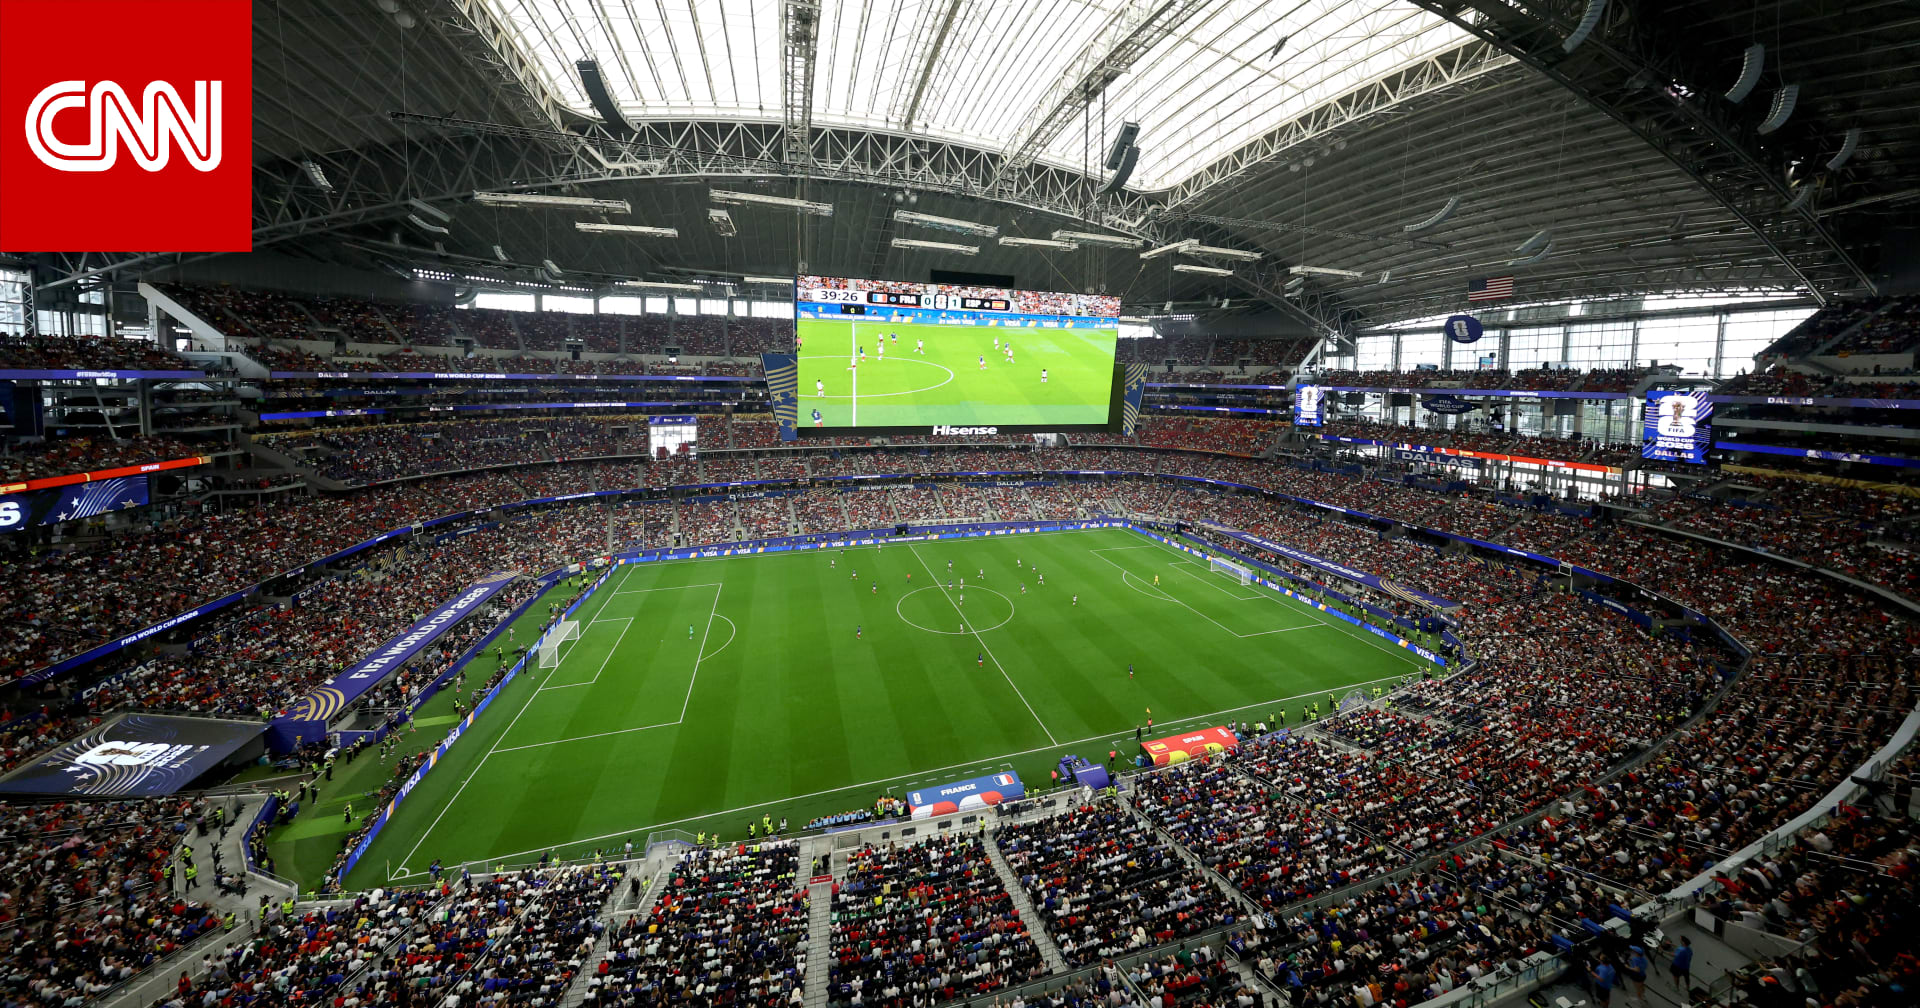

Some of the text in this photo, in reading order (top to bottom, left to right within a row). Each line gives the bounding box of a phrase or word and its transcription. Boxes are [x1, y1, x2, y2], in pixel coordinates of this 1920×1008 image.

[820, 290, 981, 308] 39:26 FRA 0 1 ESP
[933, 425, 998, 436] Hisense
[1655, 440, 1695, 450] 2026
[1401, 451, 1474, 468] DALLAS
[1654, 449, 1695, 459] DALLAS
[140, 464, 160, 472] SPAIN
[1267, 580, 1280, 591] VISA
[1297, 593, 1312, 606] VISA
[121, 610, 199, 646] FIFA WORLD CUP 2026
[348, 587, 490, 679] FIFA WORLD CUP 2026
[1370, 626, 1385, 638] VISA
[1414, 645, 1436, 662] VISA
[443, 727, 460, 750] VISA
[1182, 734, 1205, 744] SPAIN
[401, 770, 421, 797] VISA
[940, 783, 976, 796] FRANCE
[355, 835, 372, 861] VISA
